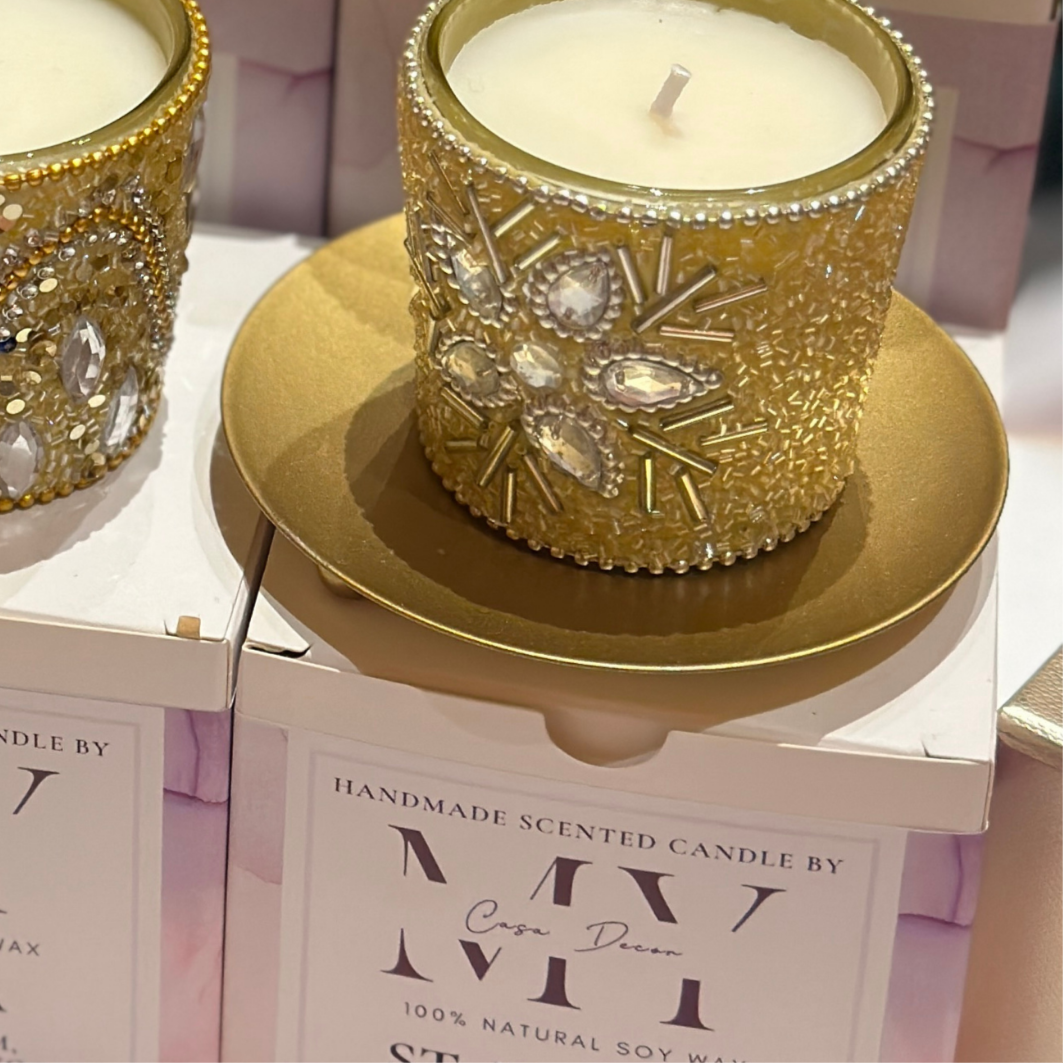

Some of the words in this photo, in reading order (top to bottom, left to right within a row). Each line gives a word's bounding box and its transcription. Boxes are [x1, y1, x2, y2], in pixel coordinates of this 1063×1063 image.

[76, 740, 111, 757] BY
[333, 777, 507, 826] HANDMADE
[520, 813, 656, 850] SCENTED
[668, 838, 793, 870] CANDLE
[806, 857, 845, 875] BY
[465, 899, 550, 937] Casa
[574, 921, 683, 958] Decor
[403, 1002, 466, 1027] 100%
[482, 1018, 599, 1050] NATURAL
[616, 1041, 673, 1063] SOY
